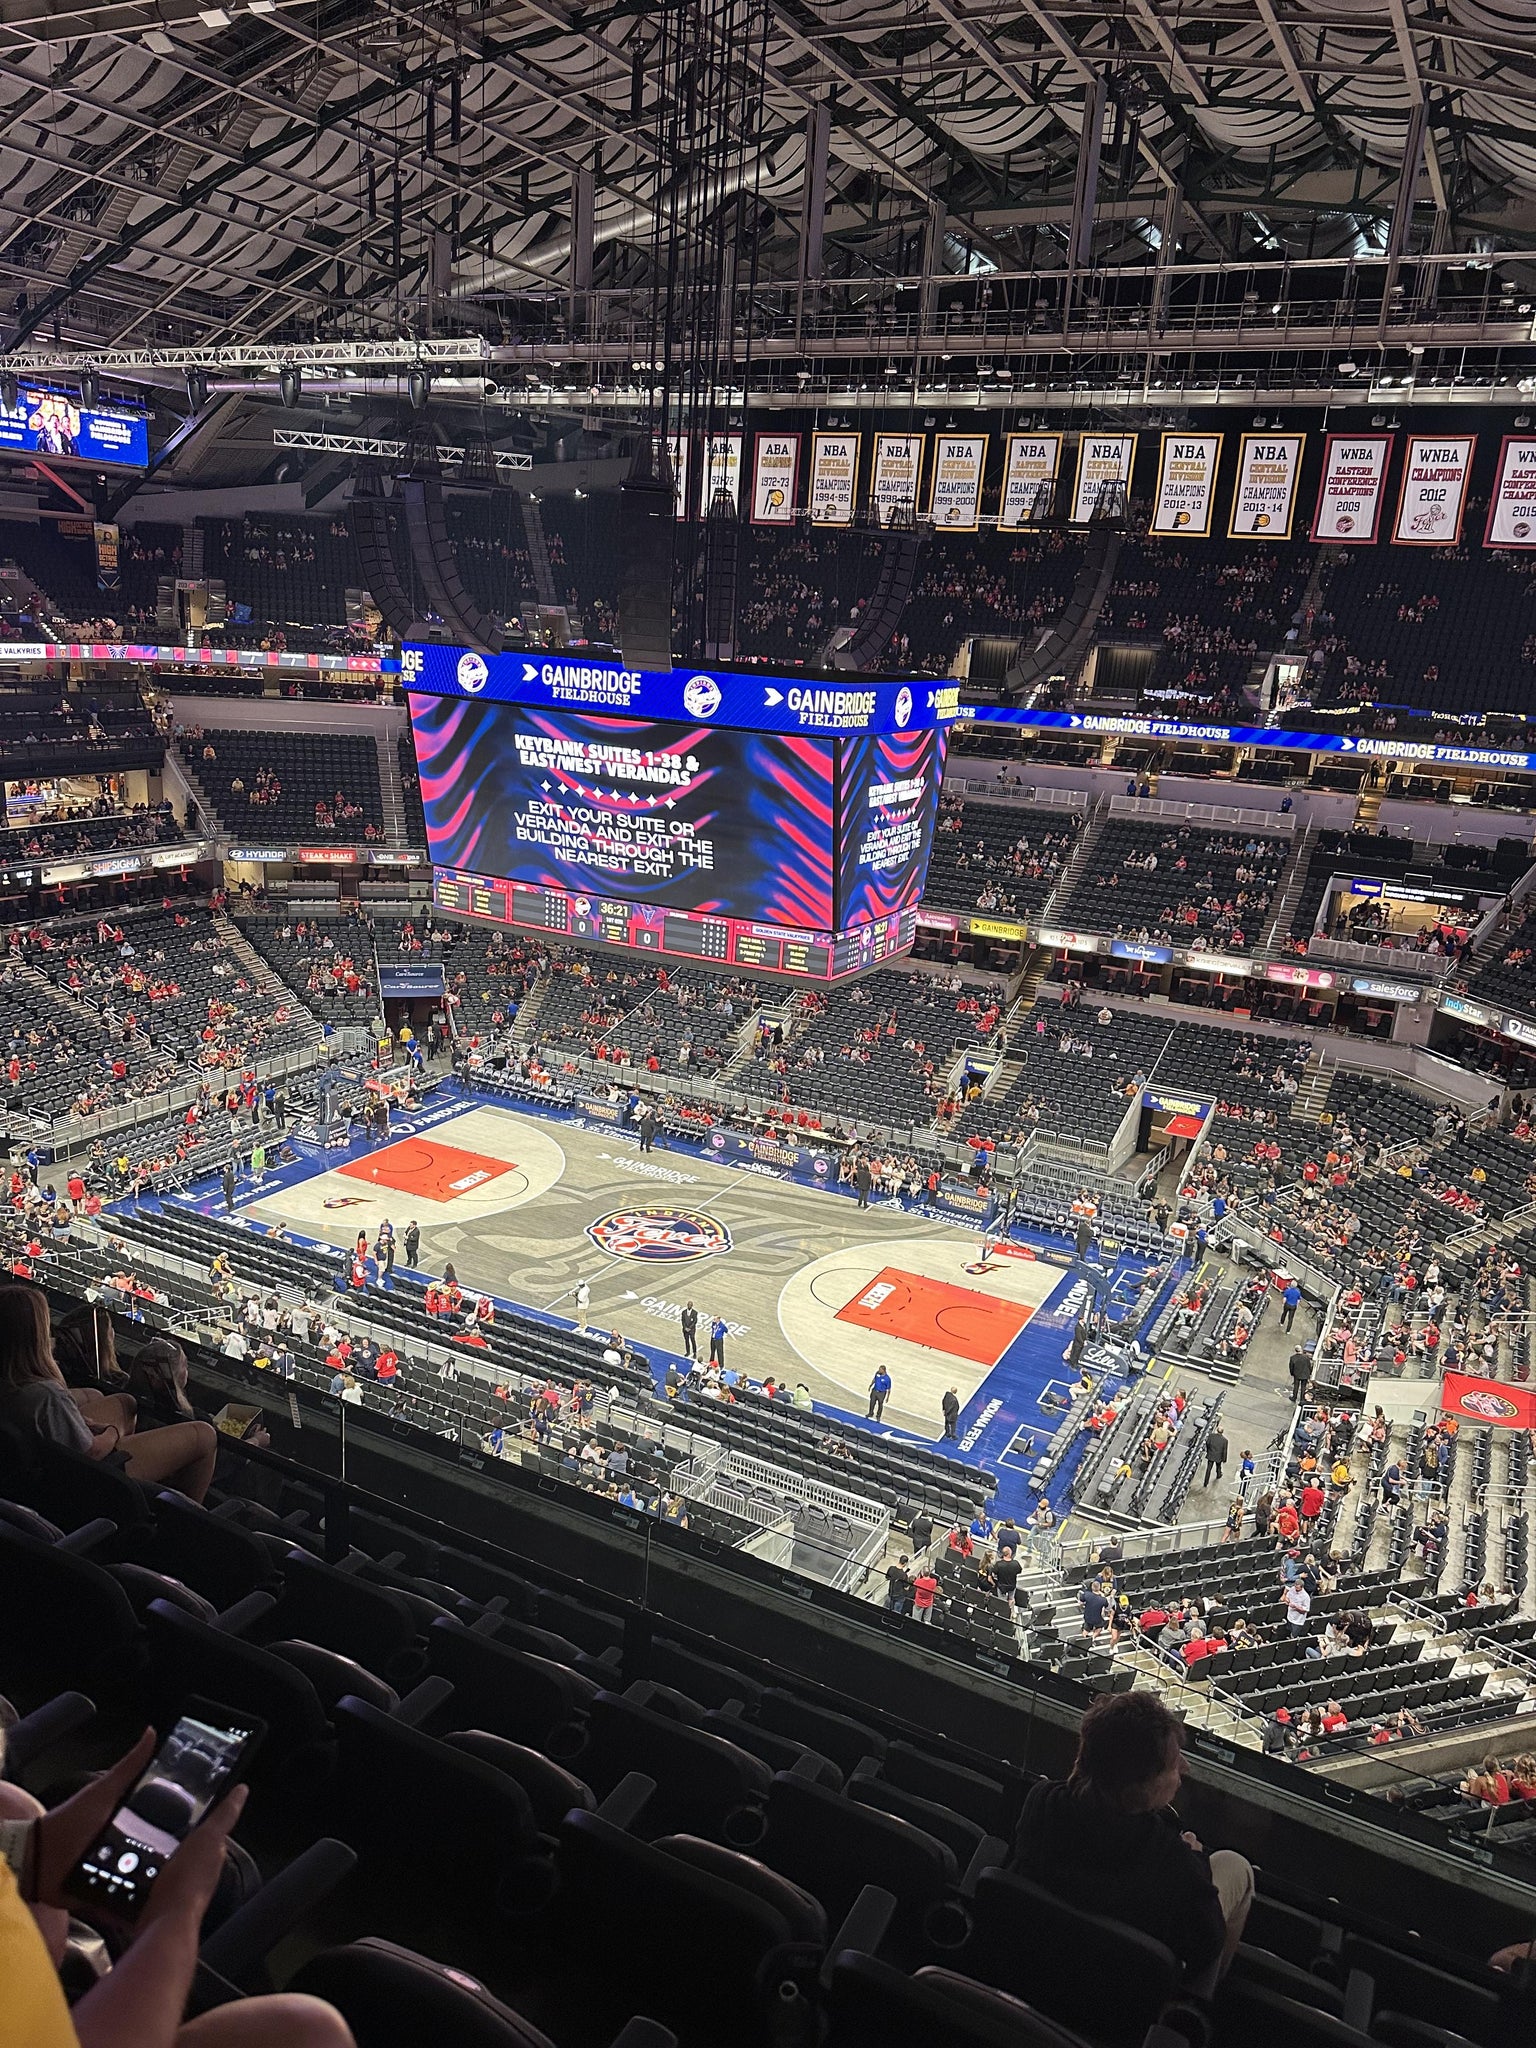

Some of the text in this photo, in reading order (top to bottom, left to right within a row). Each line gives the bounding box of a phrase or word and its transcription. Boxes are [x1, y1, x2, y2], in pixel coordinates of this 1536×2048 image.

[766, 444, 789, 455] ABA
[823, 445, 847, 456] NBA
[887, 446, 911, 457] NBA
[947, 446, 973, 457] NBA
[1020, 445, 1046, 457] NBA
[1091, 445, 1121, 458] NBA
[1174, 445, 1205, 459] NBA
[1254, 446, 1288, 460] NBA
[1341, 449, 1373, 460] WNBA
[1420, 449, 1459, 462] WNBA
[1519, 451, 1536, 463] WN
[1170, 461, 1206, 471] CENTRAL
[1250, 464, 1288, 474] CENTRAL
[1336, 467, 1373, 476] EASTERN
[1328, 477, 1378, 486] CONFERENCE
[1411, 468, 1462, 481] CHAMPIONS
[1512, 470, 1536, 479] EAST
[761, 477, 789, 487] 1972-73
[816, 479, 850, 491] CHAMPIONS
[878, 480, 913, 492] CHAMPIONS
[937, 482, 975, 493] CHAMPIONS
[815, 493, 849, 502] 1994-95
[1164, 484, 1205, 497] CHAMPIONS
[1243, 487, 1287, 499] CHAMPIONS
[1328, 487, 1374, 496] CHAMPIONS
[1419, 489, 1446, 501] 2012
[1503, 491, 1536, 500] CHAMP
[935, 496, 975, 505] 1999-2000
[1336, 501, 1360, 512] 2009
[542, 665, 642, 694] GAINBRIDGE
[552, 687, 631, 706] FIELDHOUSE
[788, 688, 877, 715] GAINBRIDGE
[799, 711, 868, 728] FIELDHOUSE
[1083, 715, 1230, 740] GAINBRIDGE FIELDHOUSE
[514, 734, 700, 772] KEYBANK SUITES 1-38 &
[1356, 739, 1528, 767] GAINBRIDGE FIELDHOUSE
[519, 750, 692, 786] EAST/WEST VERANDAS
[528, 800, 695, 837] EXIT YOUR SUITE OR
[513, 811, 714, 855] VERANDA AND EXIT THE
[881, 825, 897, 838] YOUR
[516, 826, 714, 870] BUILDING THROUGH THE
[860, 838, 889, 853] VERANDA
[889, 835, 901, 848] AND
[246, 850, 287, 858] HYUNDAI
[301, 851, 353, 860] STEAK SHAKE
[859, 848, 886, 864] BUILDING
[93, 857, 141, 873] SHIPSIGMA
[554, 847, 673, 878] NEAREST EXIT.
[872, 854, 897, 871] NEAREST
[600, 902, 629, 918] 36:21
[578, 921, 586, 933] 0
[981, 923, 1025, 938] GAINBRIDGE
[643, 932, 651, 945] 0
[1370, 982, 1419, 998] salesforce
[412, 1101, 477, 1126] FANDUEL
[585, 1103, 618, 1118] GAINBRIDGE
[298, 1125, 319, 1140] Lilly
[748, 1142, 800, 1163] GAINBRIDGE
[614, 1156, 700, 1185] GAINBRIDGE
[617, 1164, 684, 1185] FIELDHOUSE
[944, 1193, 988, 1210] GAINBRIDGE
[914, 1203, 983, 1224] Ascension
[633, 1208, 716, 1236] INDIANA
[929, 1212, 982, 1230] Vincent
[590, 1215, 734, 1252] Fever
[1083, 1348, 1120, 1370] Lilly
[957, 1398, 1004, 1452] INDIANA FEVER
